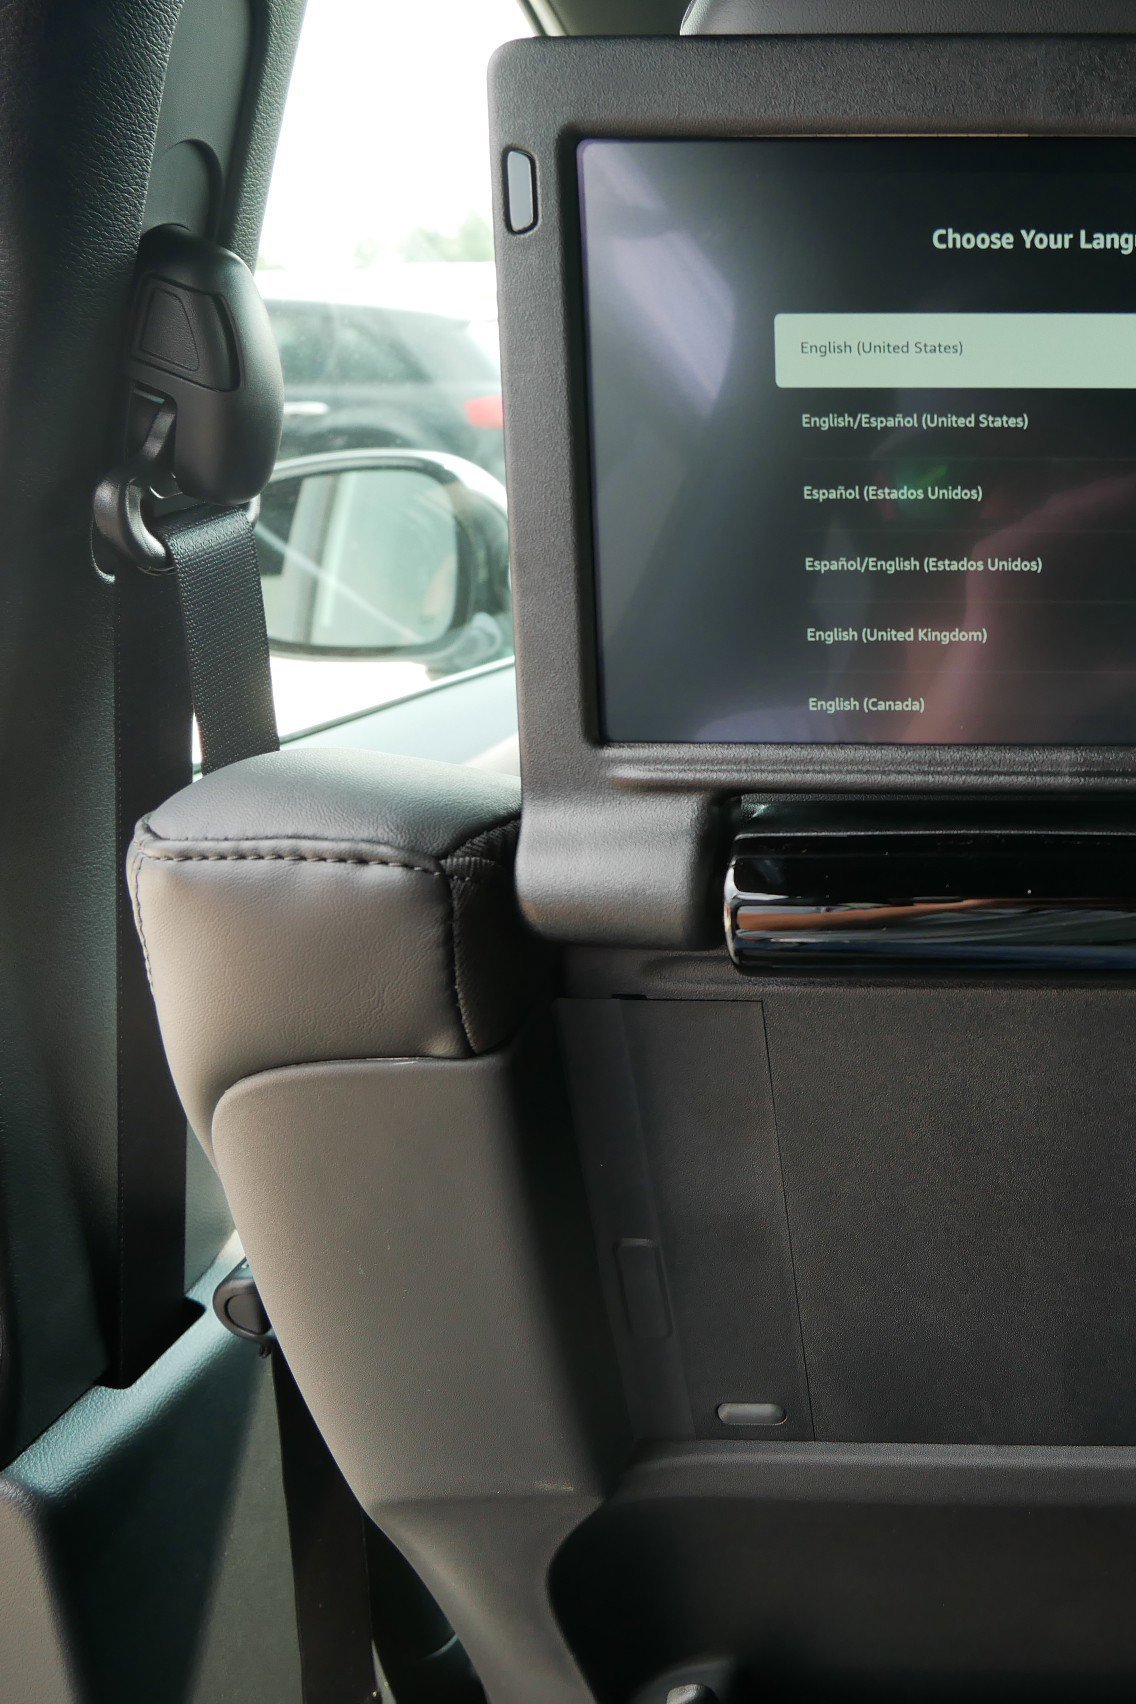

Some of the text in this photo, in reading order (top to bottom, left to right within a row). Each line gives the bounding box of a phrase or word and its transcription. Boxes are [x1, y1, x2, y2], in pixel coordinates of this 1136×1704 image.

[931, 227, 1014, 251] Choose
[1020, 227, 1073, 251] Your
[800, 340, 964, 357] English (United States)
[801, 412, 1029, 431] English/Español (United States)
[803, 485, 983, 503] Español (Estados Unidos)
[805, 556, 1043, 574] Español/English (Estados Unidos)
[807, 627, 988, 645] English (United Kingdom)
[808, 697, 925, 715] English (Canada)
